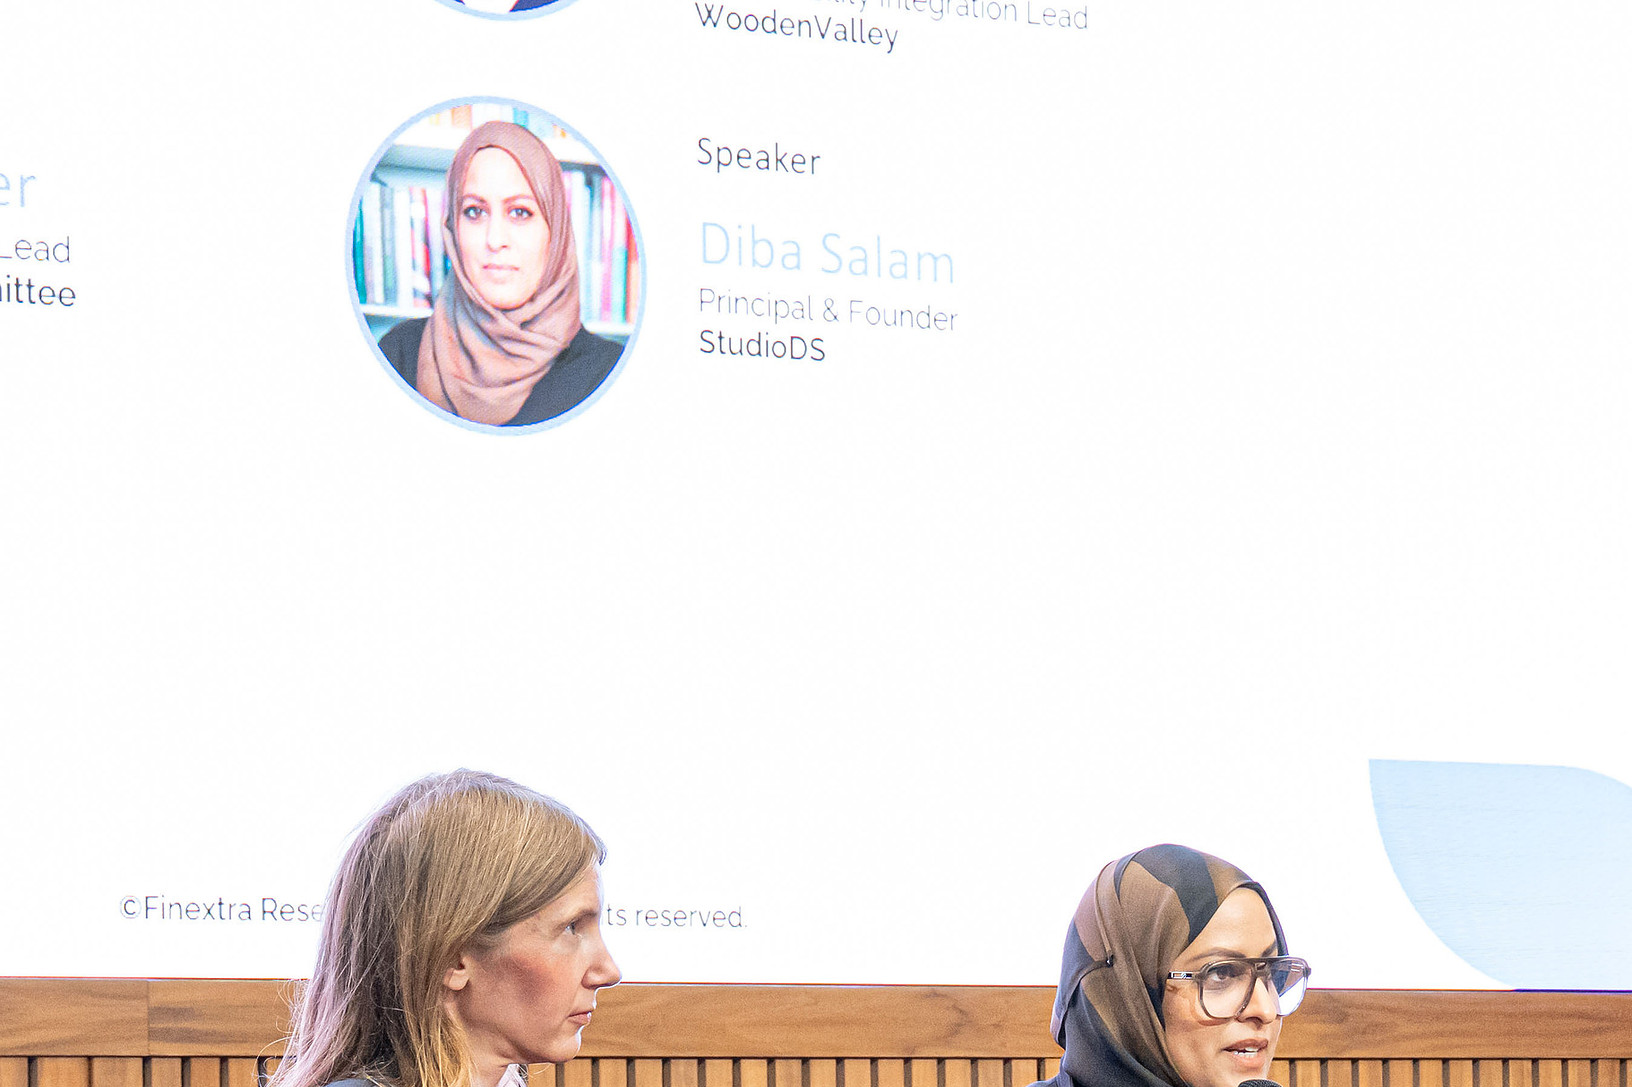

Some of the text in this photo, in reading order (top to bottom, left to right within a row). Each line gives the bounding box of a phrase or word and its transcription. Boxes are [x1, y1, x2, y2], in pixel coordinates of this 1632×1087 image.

[695, 2, 899, 54] WoodenValley
[1027, 0, 1089, 30] Lead
[697, 137, 821, 175] Speaker
[702, 222, 954, 284] Diba Salam
[700, 288, 958, 331] Principal & Founder
[700, 329, 826, 362] StudioDS
[636, 906, 748, 928] reserved.
